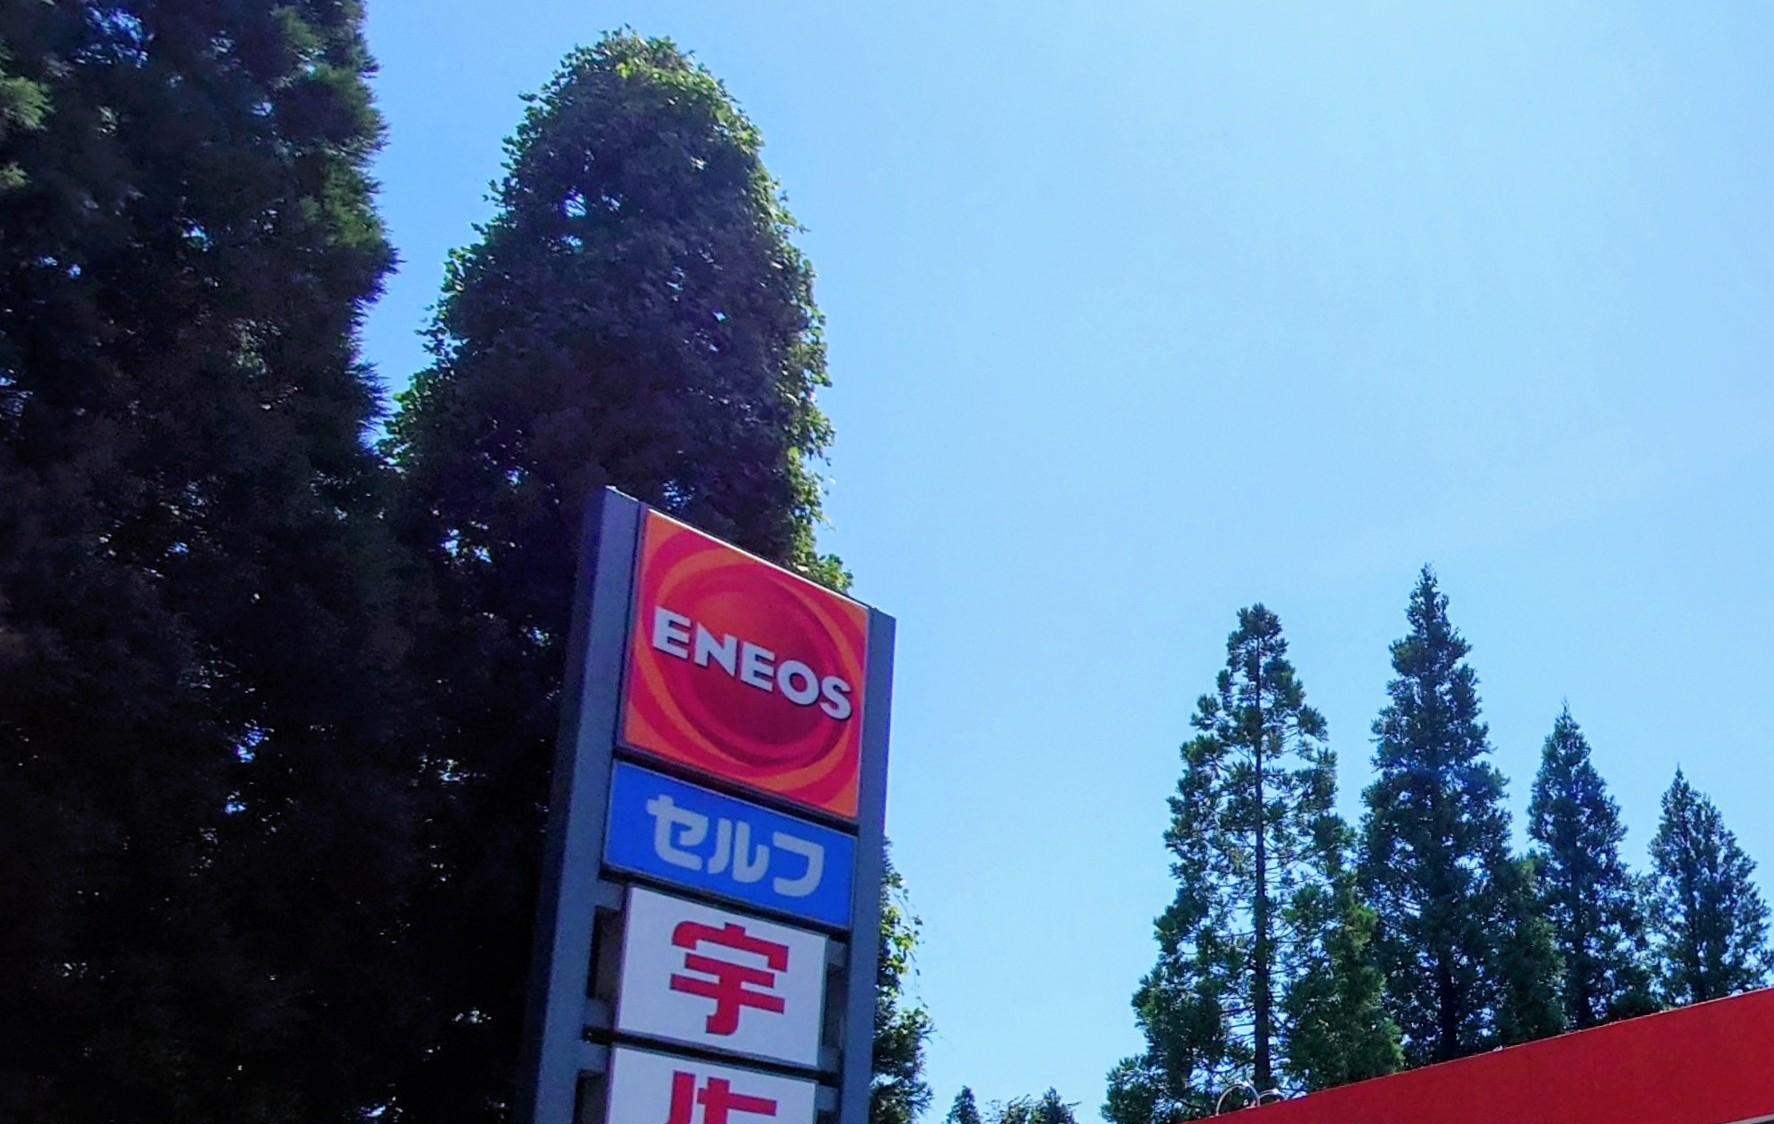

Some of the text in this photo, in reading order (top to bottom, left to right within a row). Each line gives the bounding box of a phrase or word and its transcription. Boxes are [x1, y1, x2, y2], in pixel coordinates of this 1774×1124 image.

[652, 606, 852, 720] ENEOS
[646, 794, 825, 897] セルフ
